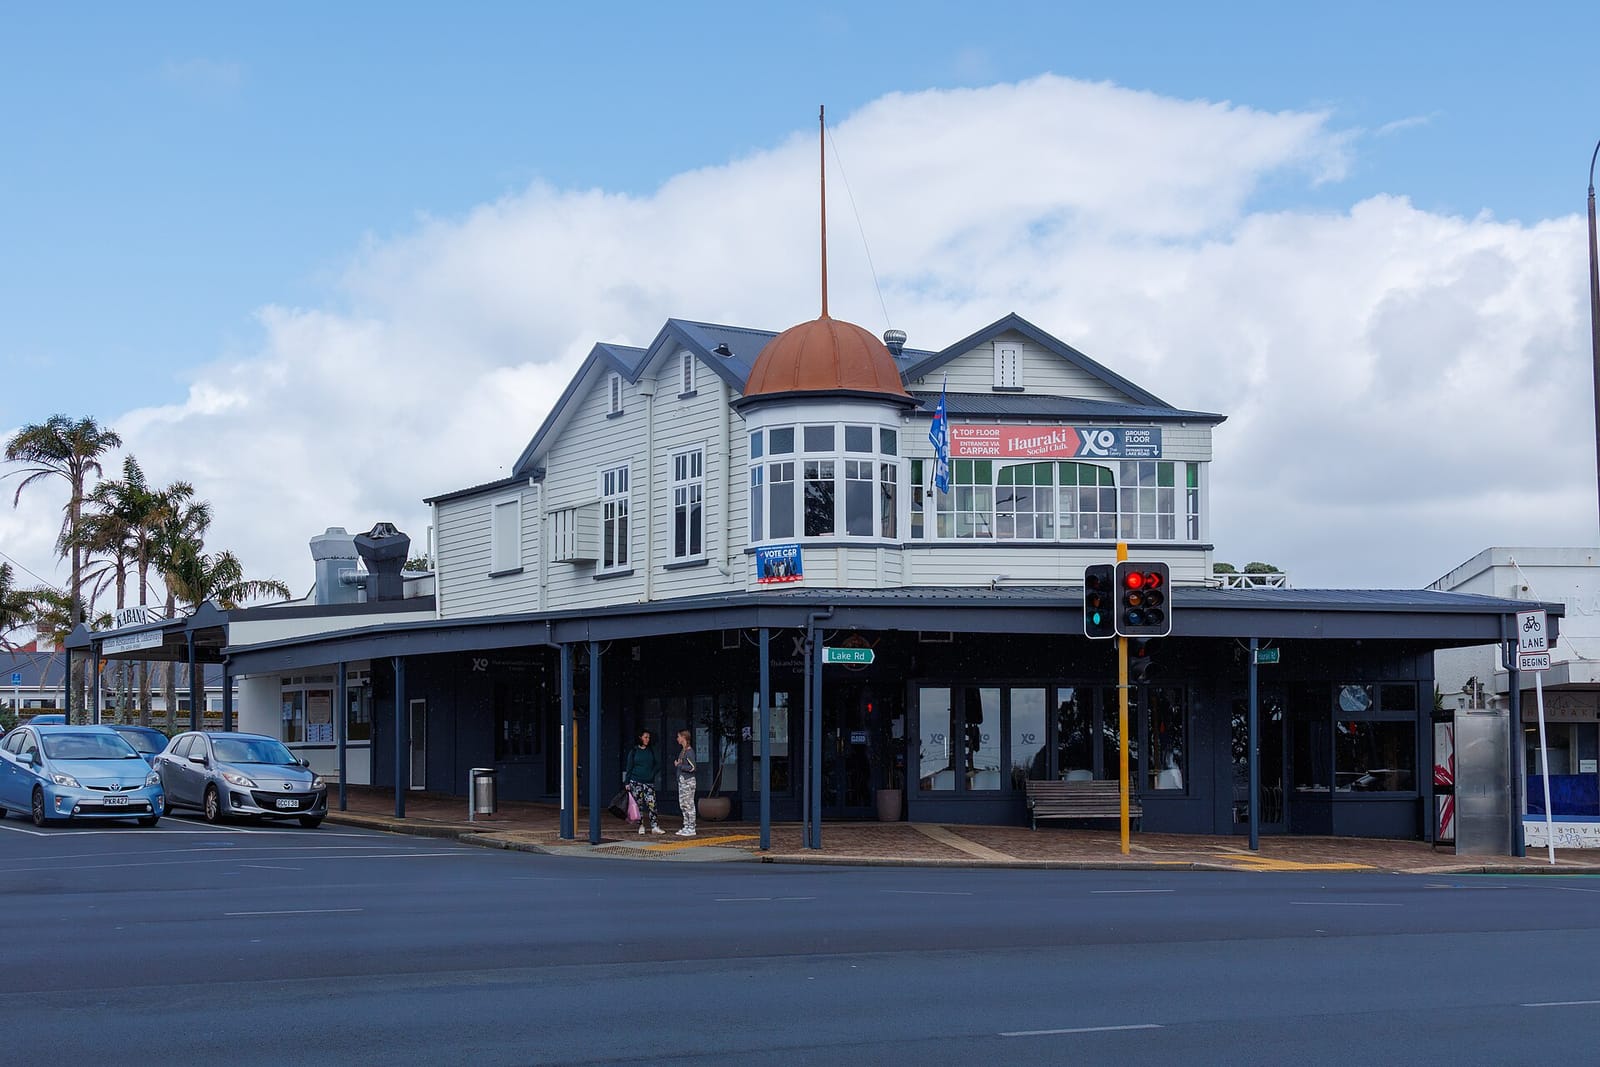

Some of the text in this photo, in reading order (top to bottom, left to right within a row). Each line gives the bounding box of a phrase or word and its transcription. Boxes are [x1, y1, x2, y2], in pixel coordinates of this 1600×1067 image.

[959, 428, 1000, 436] TOP FLOOR
[1008, 429, 1067, 451] Hauraki
[1080, 430, 1115, 456] XO
[959, 447, 1000, 455] CARPARK
[1026, 446, 1049, 456] Social
[764, 550, 782, 558] VOTE
[116, 608, 147, 629] KABANA
[1522, 637, 1544, 649] LANE
[831, 651, 865, 660] Lake Rd
[1522, 657, 1548, 667] BEGINS
[1527, 708, 1595, 717] HURAKI
[104, 797, 128, 805] PKR427
[1525, 826, 1600, 835] HAURKI
